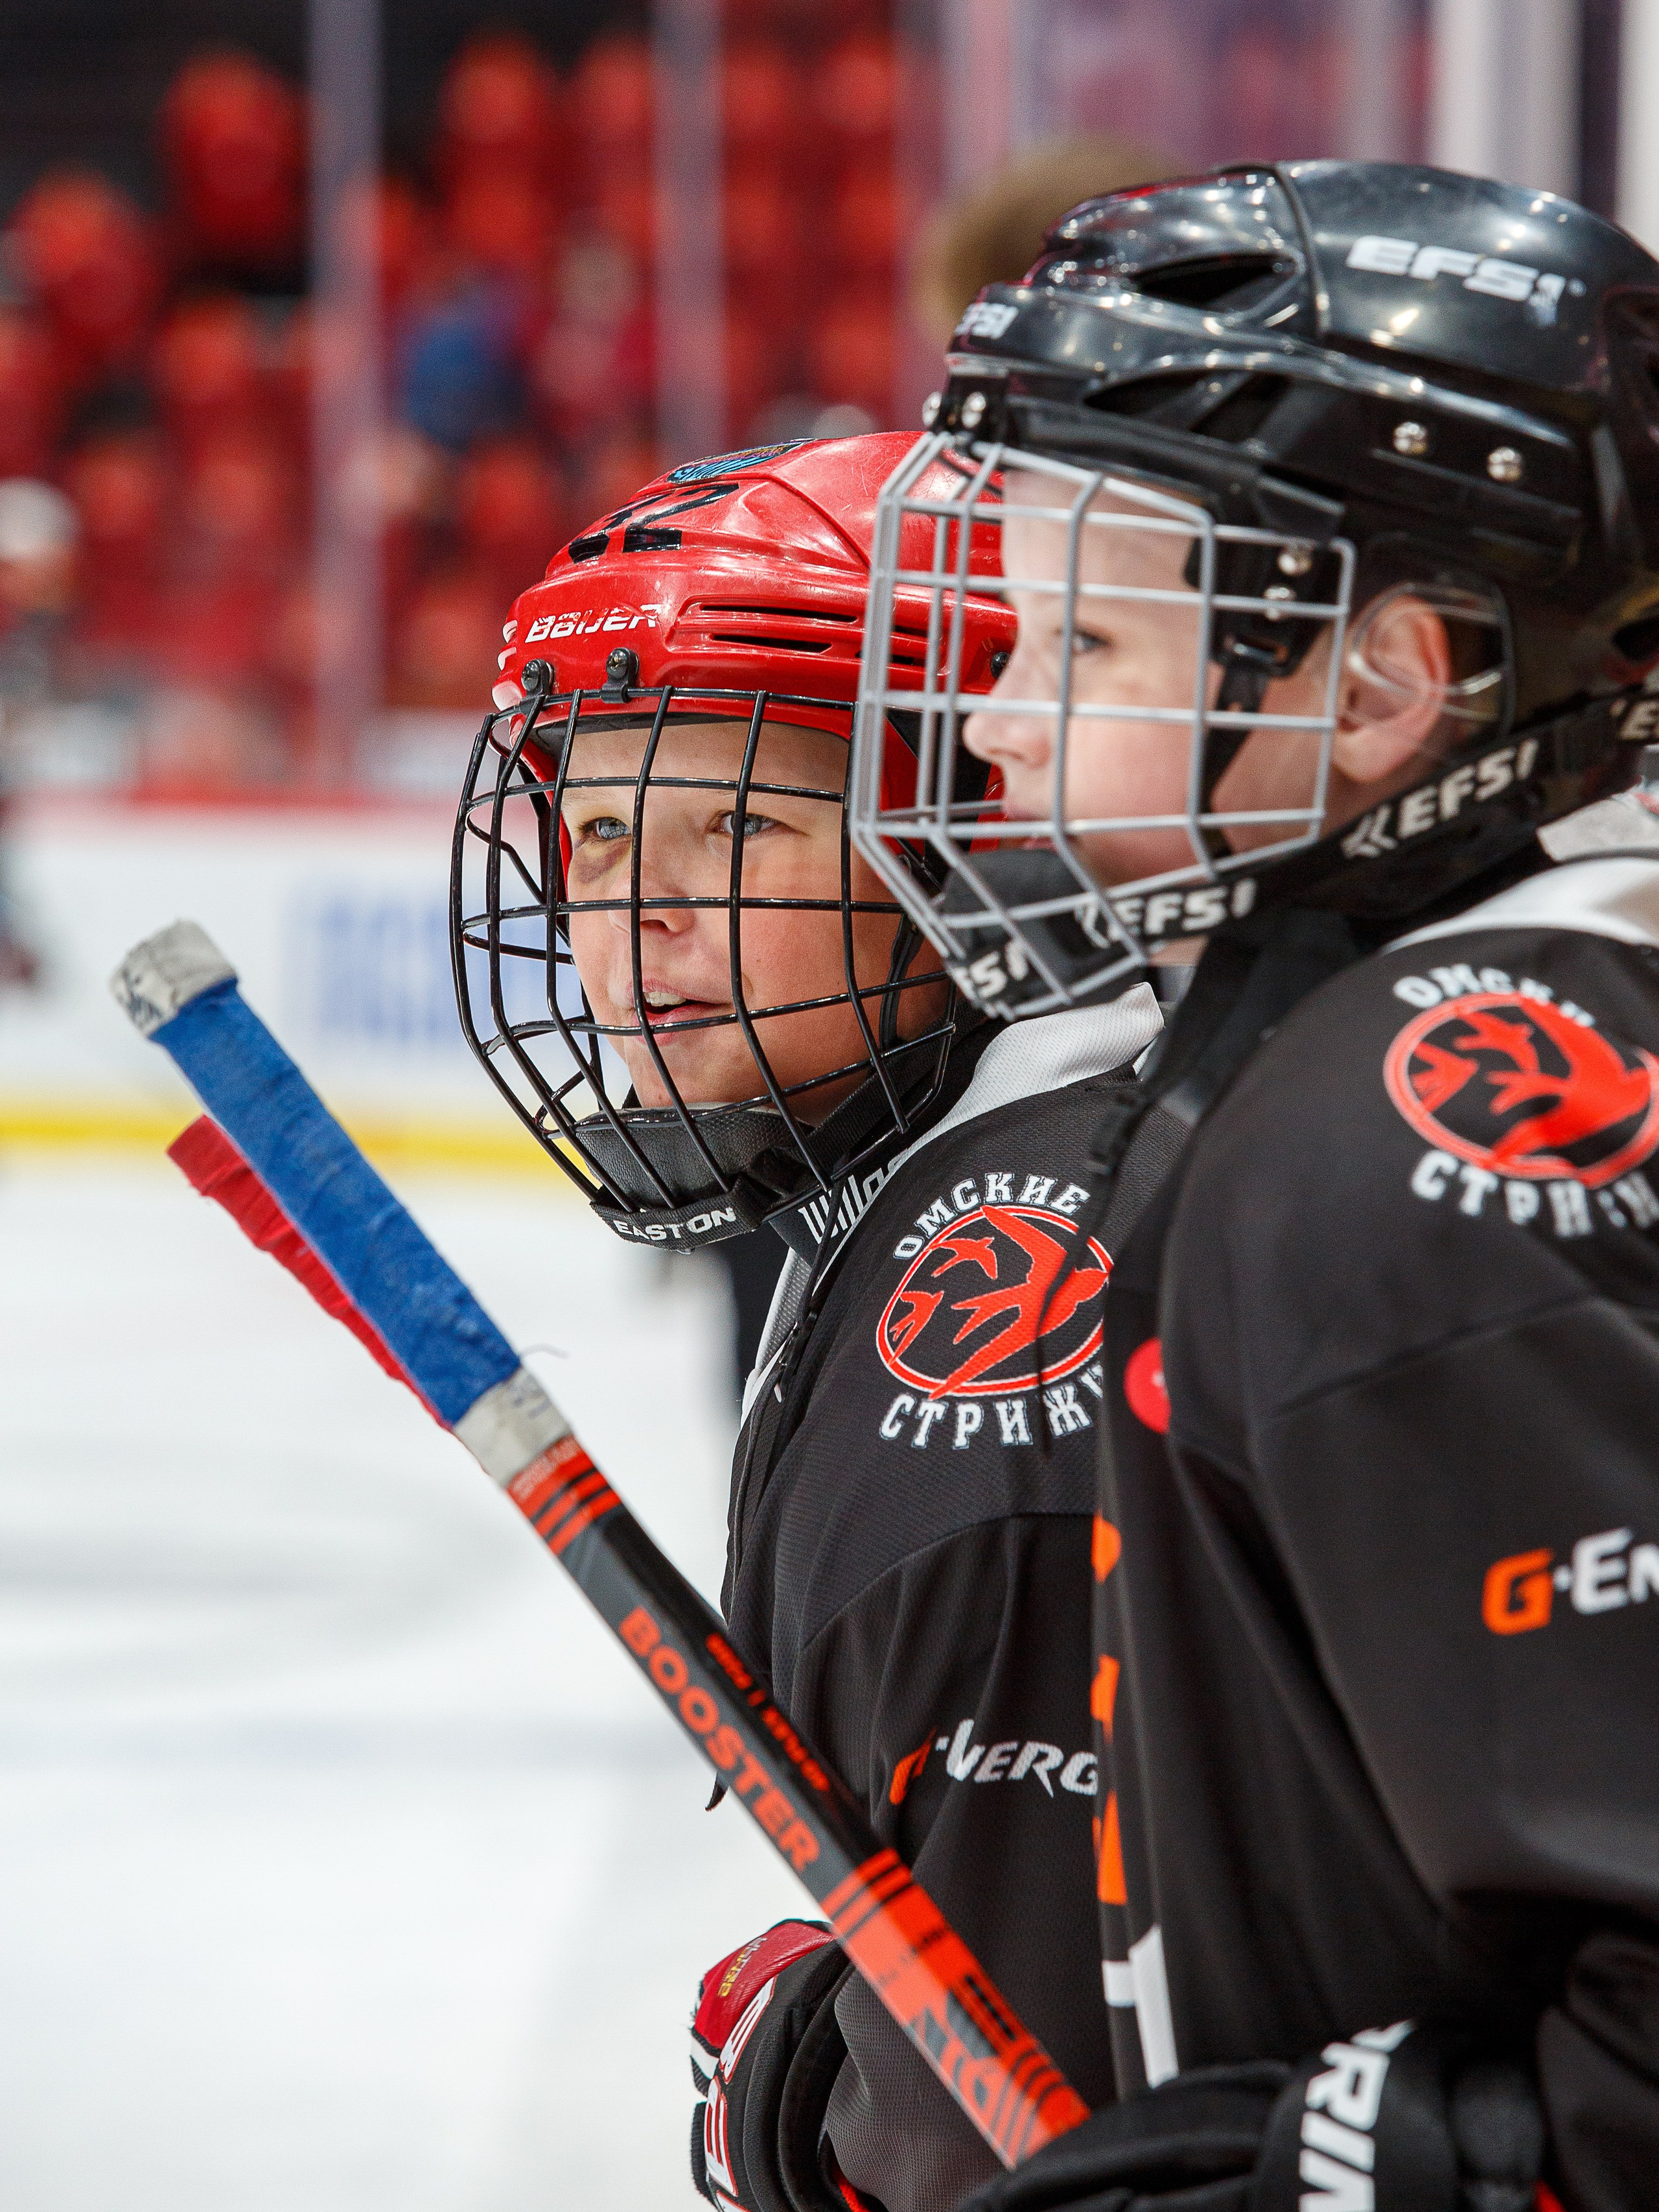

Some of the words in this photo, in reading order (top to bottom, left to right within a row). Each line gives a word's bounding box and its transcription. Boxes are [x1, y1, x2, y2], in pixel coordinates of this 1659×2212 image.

[612, 1207, 736, 1242] EASTON
[893, 1172, 1090, 1259] ОМСКИЕ
[619, 1604, 821, 1873] BOOSTER
